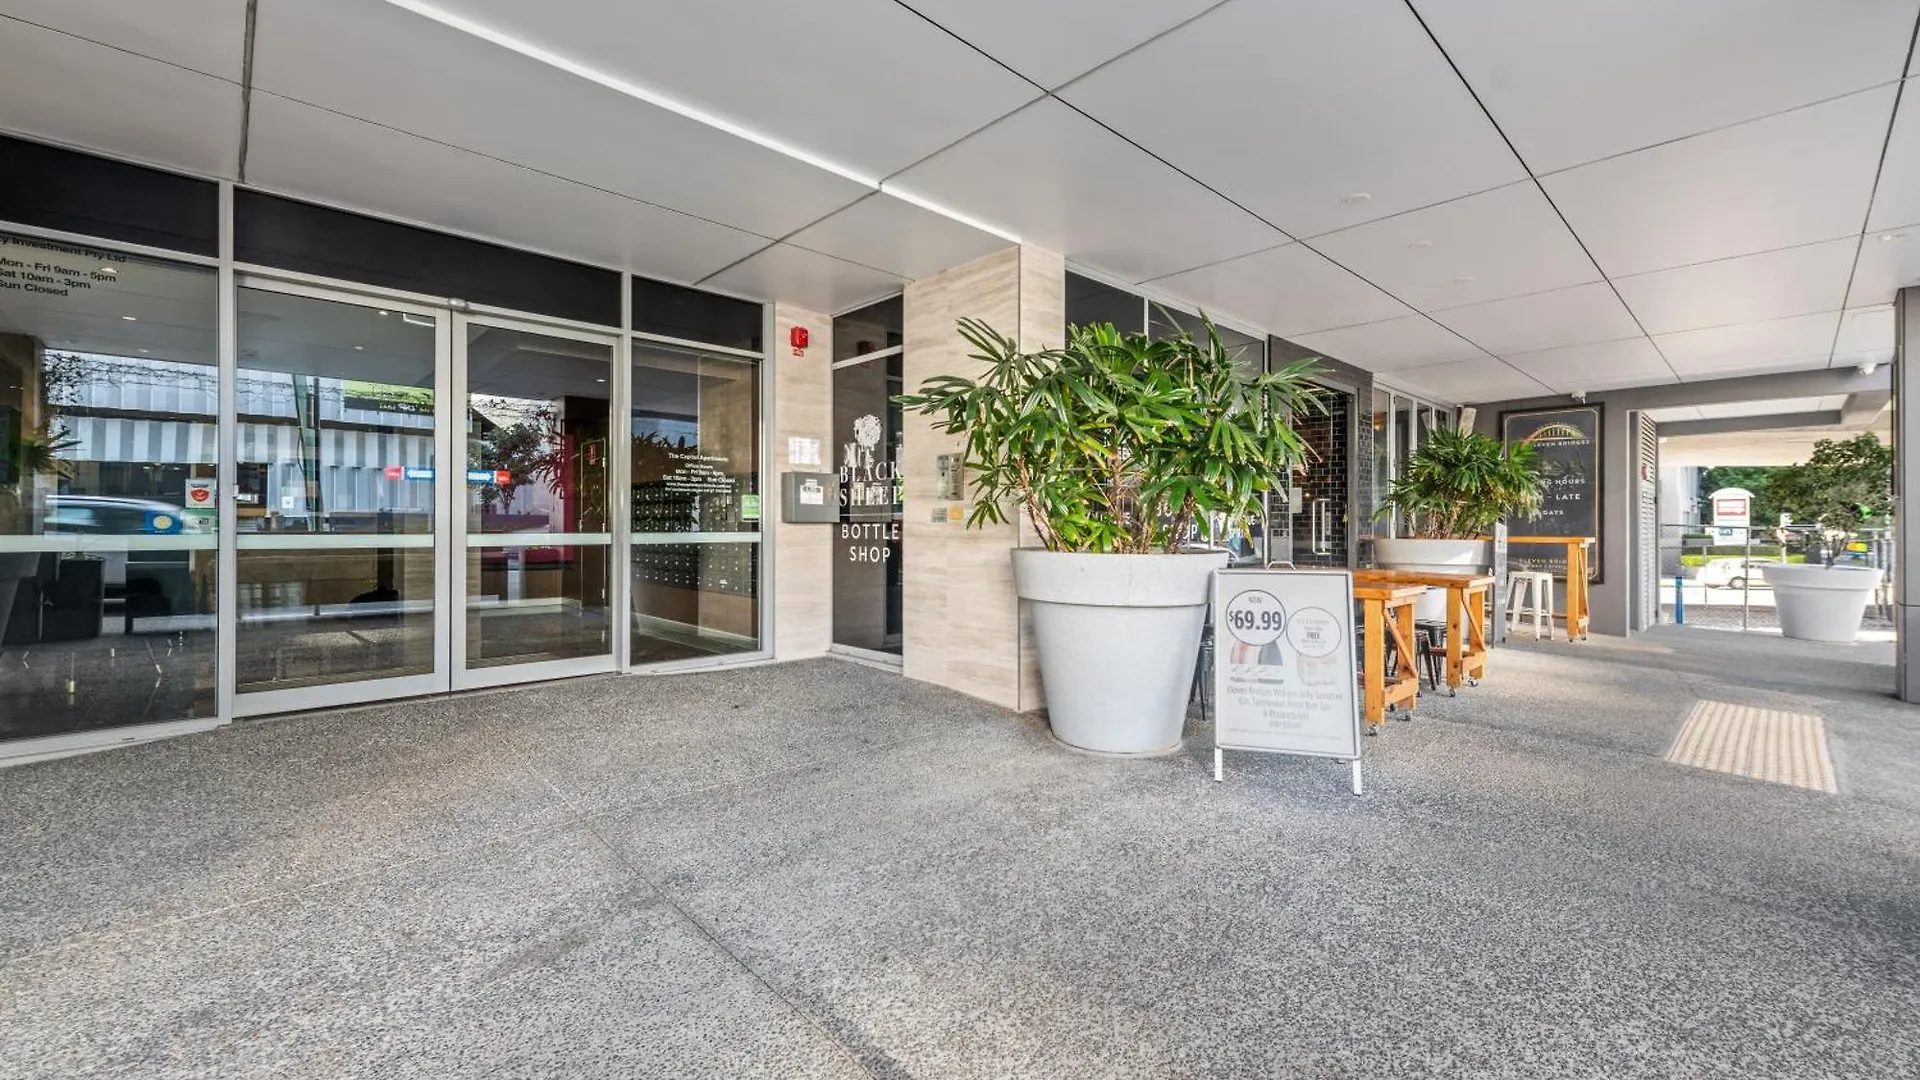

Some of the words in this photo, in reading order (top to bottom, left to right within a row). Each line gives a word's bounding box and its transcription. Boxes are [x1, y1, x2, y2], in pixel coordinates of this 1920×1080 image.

[13, 237, 82, 255] Investment
[84, 249, 103, 260] Pty
[107, 252, 126, 263] Ltd
[21, 271, 54, 283] 10am
[64, 278, 91, 289] 3pm
[34, 262, 51, 272] Fri
[54, 265, 80, 277] 9am
[90, 271, 117, 282] 5pm
[24, 283, 69, 297] Closed
[840, 461, 903, 483] BLACK
[841, 523, 900, 541] BOTTLE
[849, 545, 891, 563] SHOP
[1228, 610, 1282, 631] $69.99
